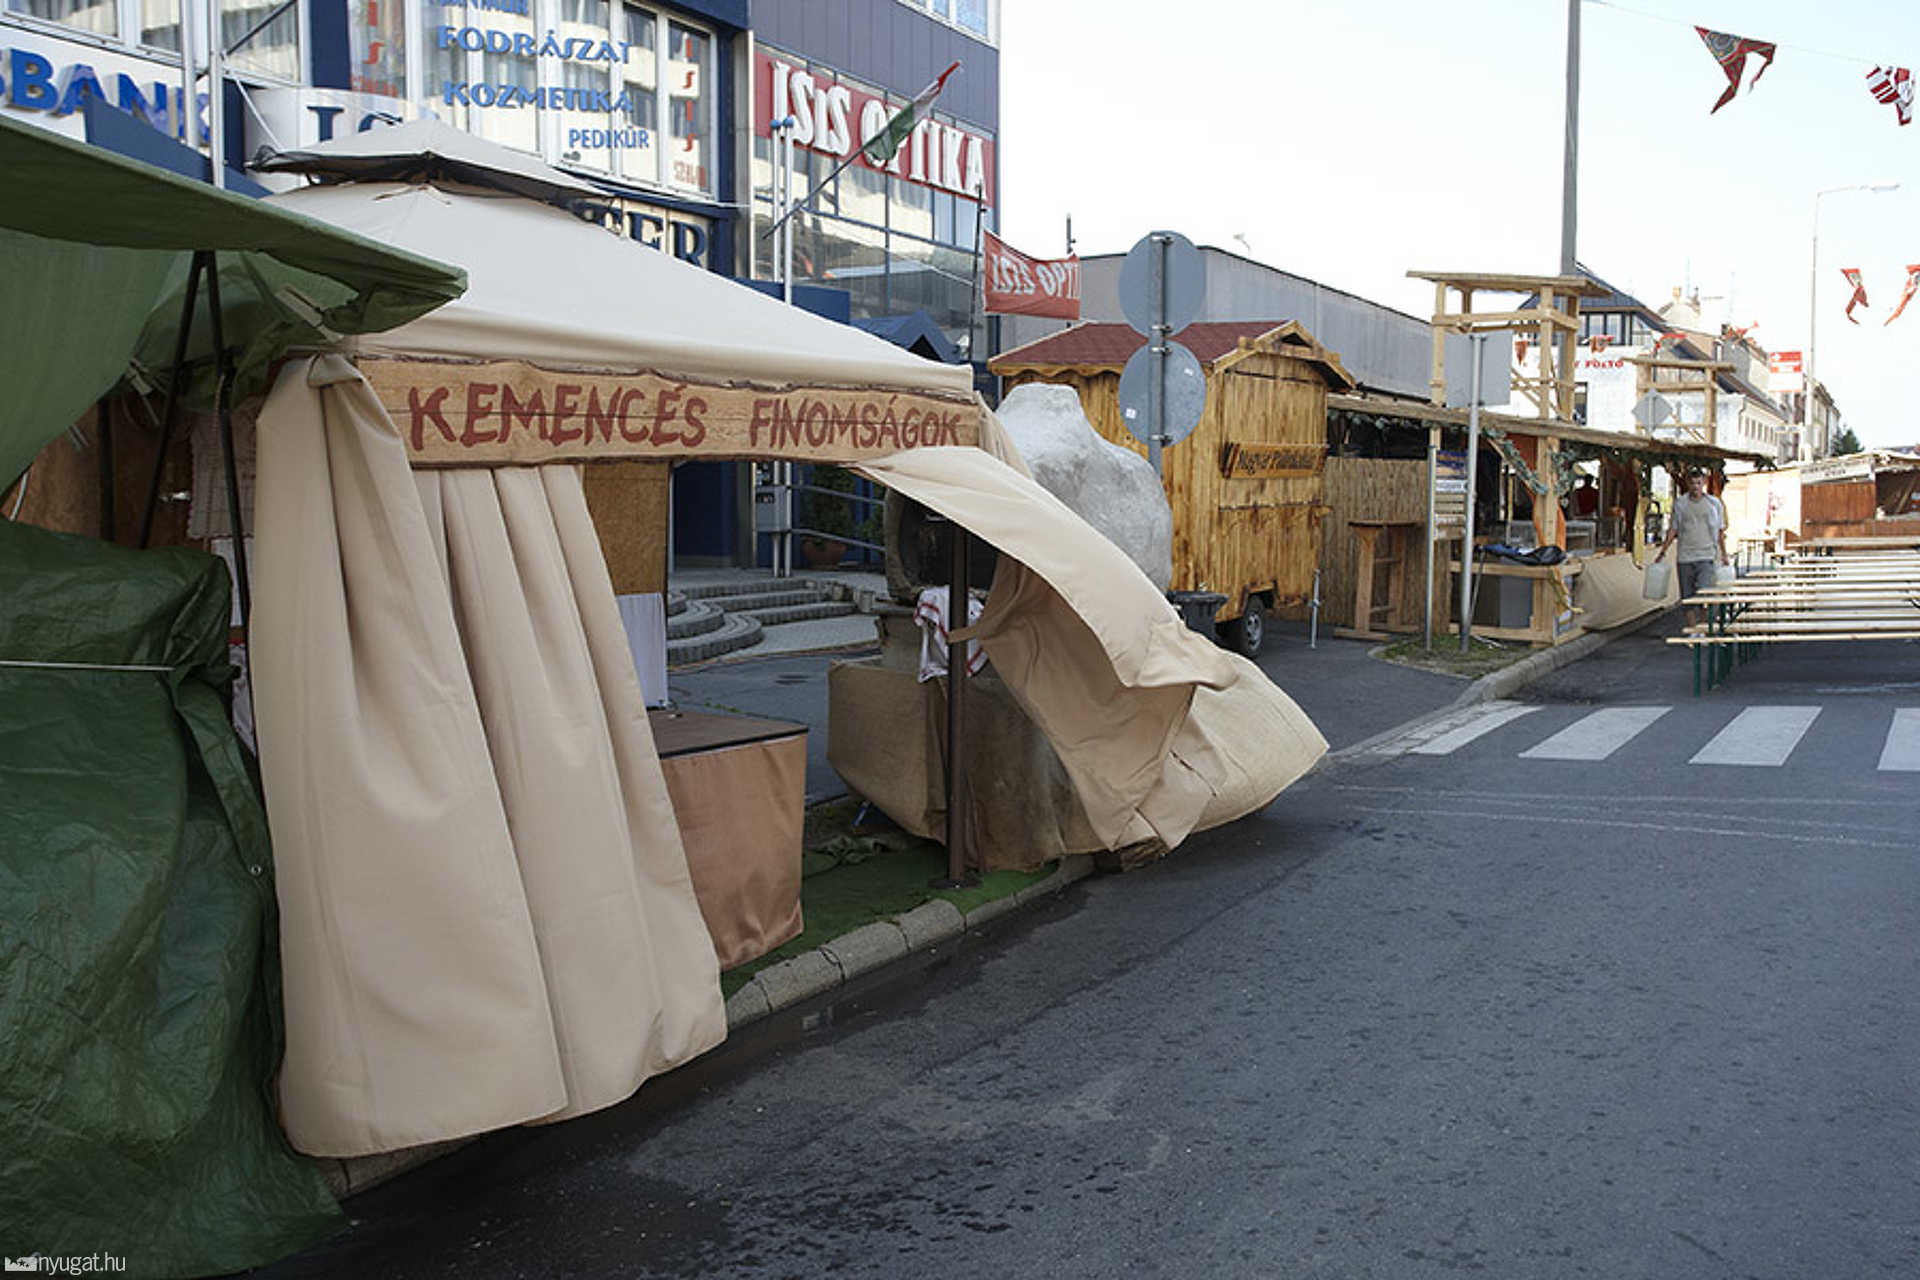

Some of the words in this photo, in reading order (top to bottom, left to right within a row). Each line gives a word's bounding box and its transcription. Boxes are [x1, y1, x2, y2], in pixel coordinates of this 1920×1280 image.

[436, 25, 632, 65] FODRÁSZAT
[0, 48, 210, 143] BANK
[443, 80, 633, 113] KOZMETIKA
[773, 60, 851, 155] ISIS
[992, 254, 1035, 295] ISIS
[408, 382, 708, 451] KEMENCÉS
[751, 394, 961, 449] FINOMSÁGOK
